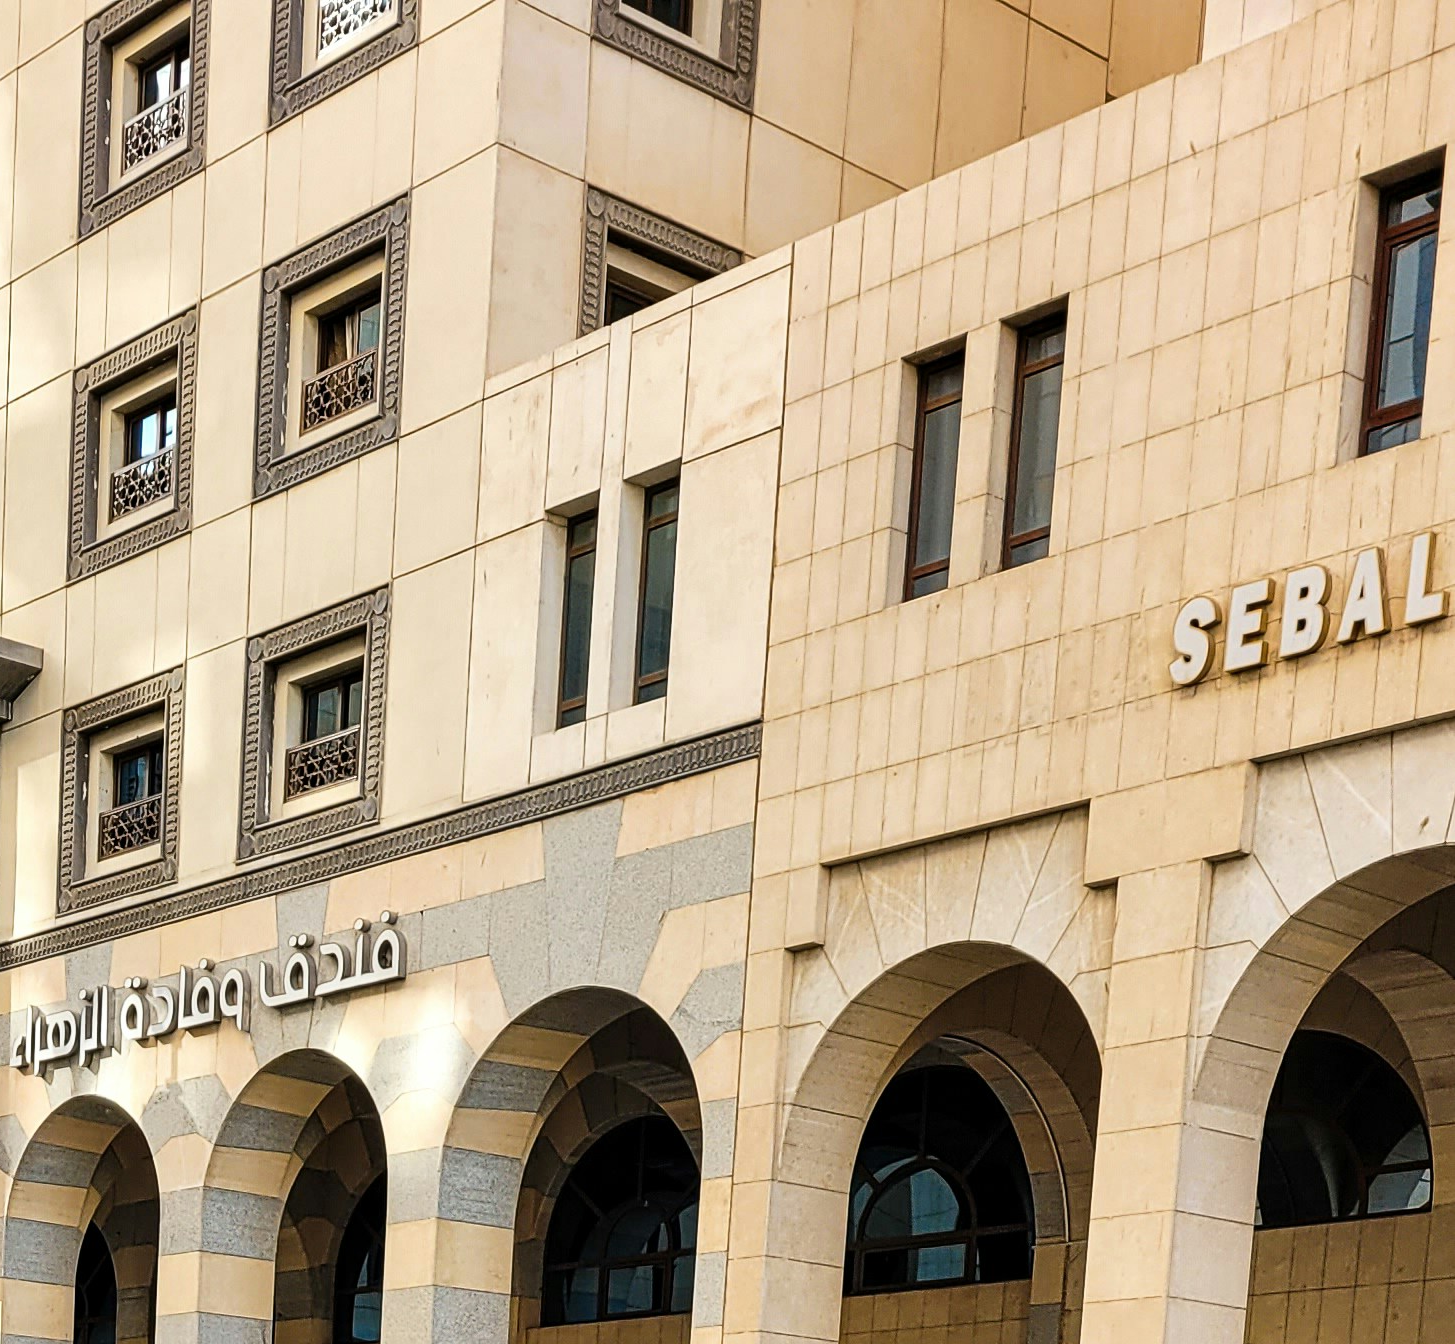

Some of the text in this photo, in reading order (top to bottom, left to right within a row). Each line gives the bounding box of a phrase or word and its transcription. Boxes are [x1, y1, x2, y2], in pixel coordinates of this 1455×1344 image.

[1168, 532, 1450, 686] SEBAL
[10, 910, 407, 1078] فندق وفادة الزهراء
